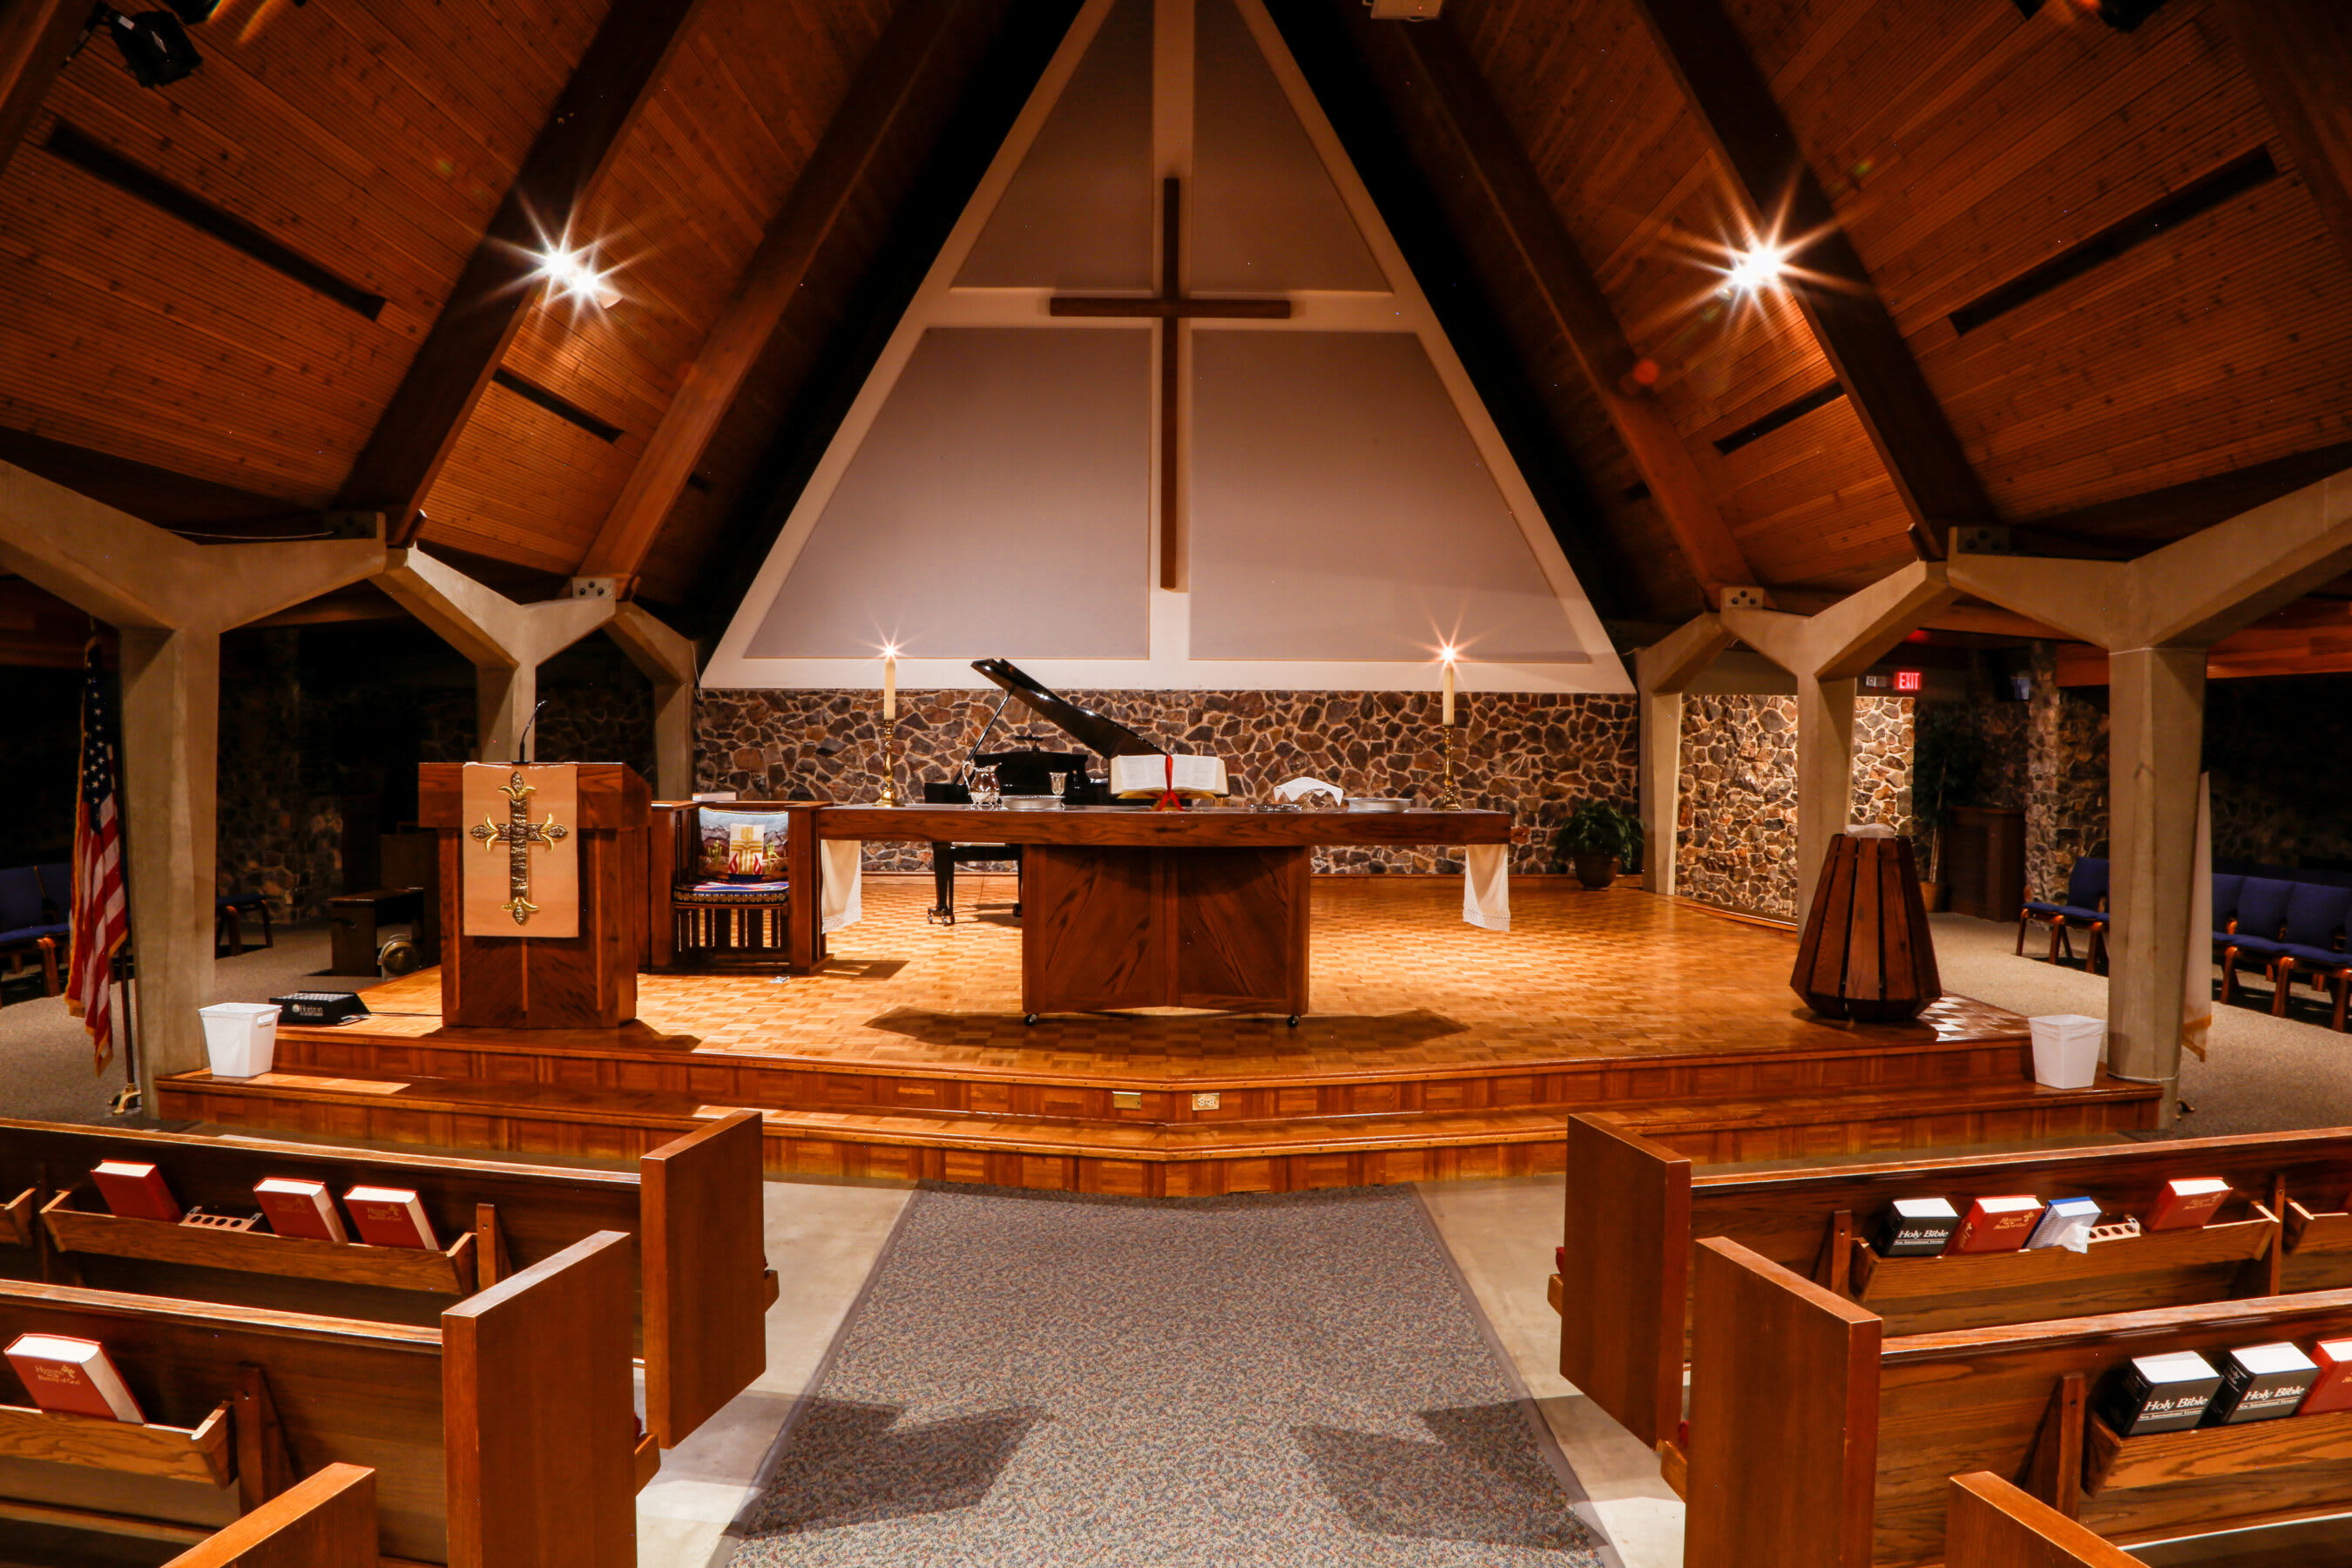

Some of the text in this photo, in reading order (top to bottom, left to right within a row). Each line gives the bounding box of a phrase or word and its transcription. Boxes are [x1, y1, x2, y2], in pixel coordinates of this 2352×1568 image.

[1899, 672, 1920, 689] EXIT
[1898, 1230, 1923, 1240] Holy
[2244, 1385, 2306, 1401] Holy Bible
[2144, 1396, 2209, 1411] Holy Bible
